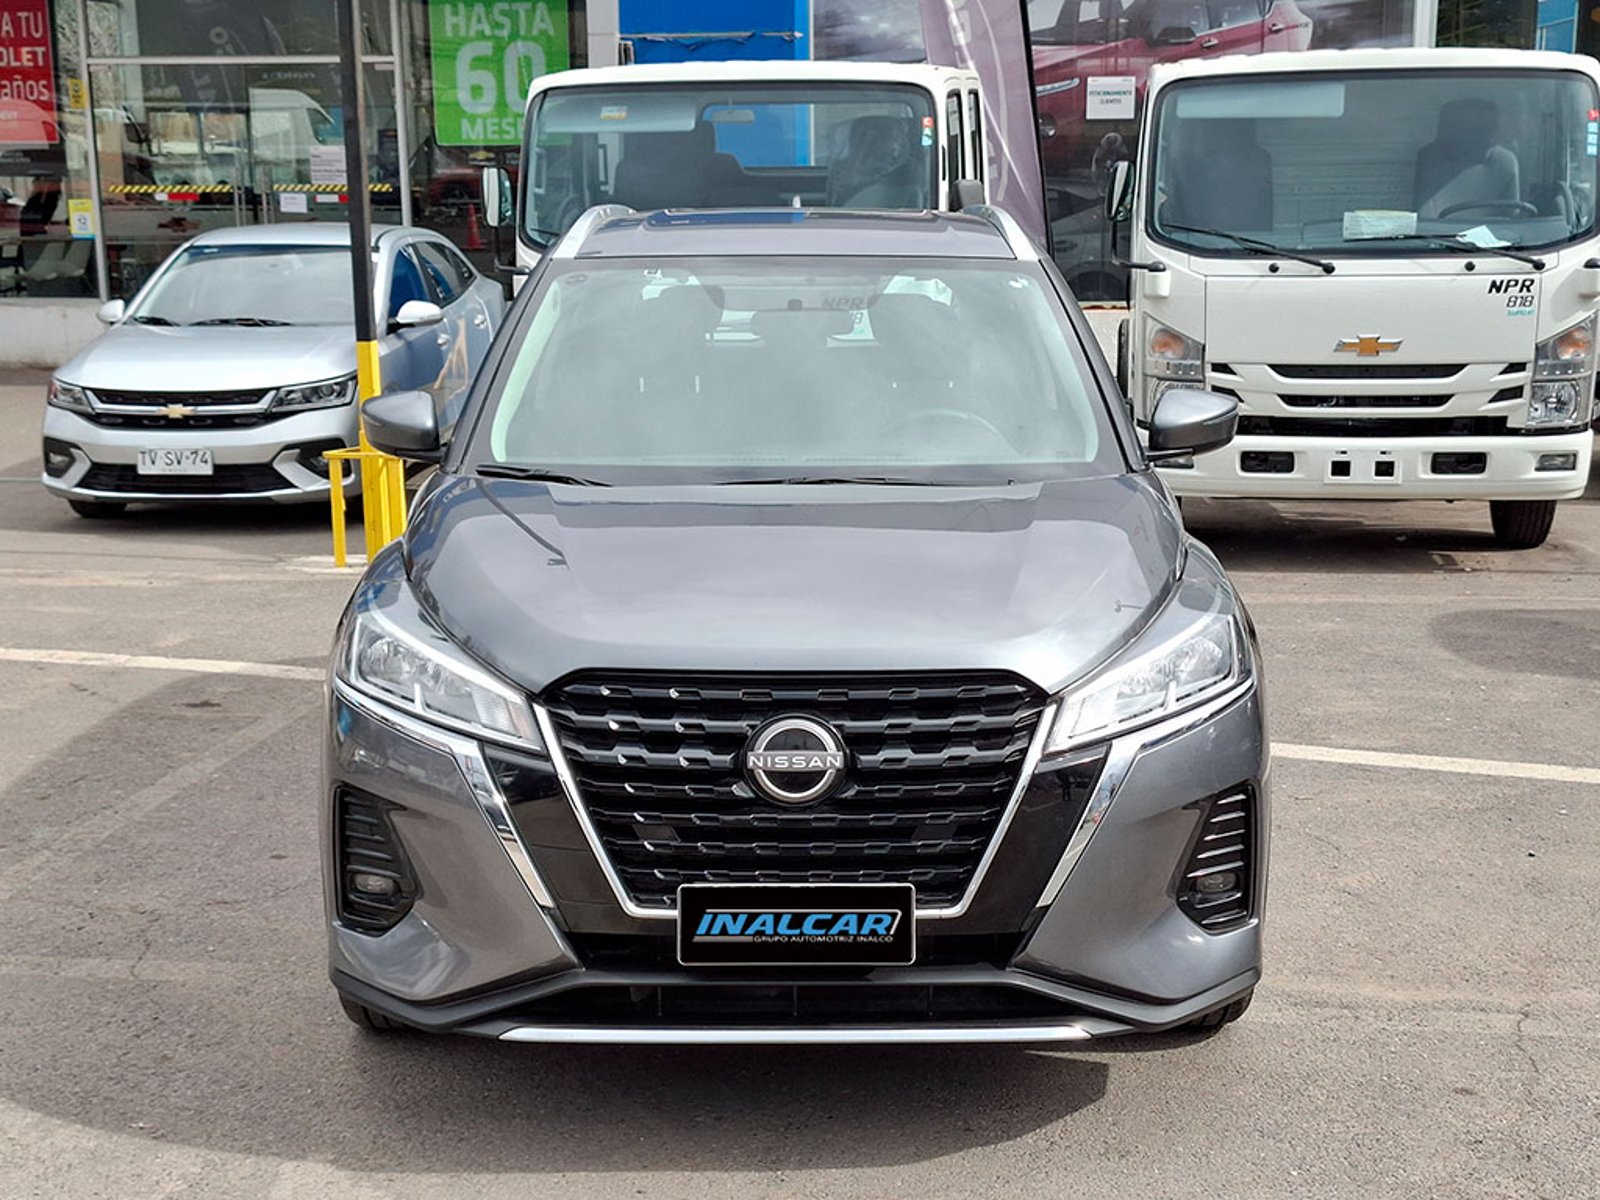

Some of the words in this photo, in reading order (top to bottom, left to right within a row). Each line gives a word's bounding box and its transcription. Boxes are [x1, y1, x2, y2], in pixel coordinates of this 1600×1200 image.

[16, 11, 43, 38] TU
[444, 2, 555, 37] HASTA
[0, 75, 50, 101] años
[456, 40, 546, 115] 60
[461, 117, 525, 140] MES
[1487, 278, 1535, 294] NPR
[1506, 294, 1535, 308] 818
[139, 449, 158, 466] TV
[749, 754, 842, 769] NISSAN
